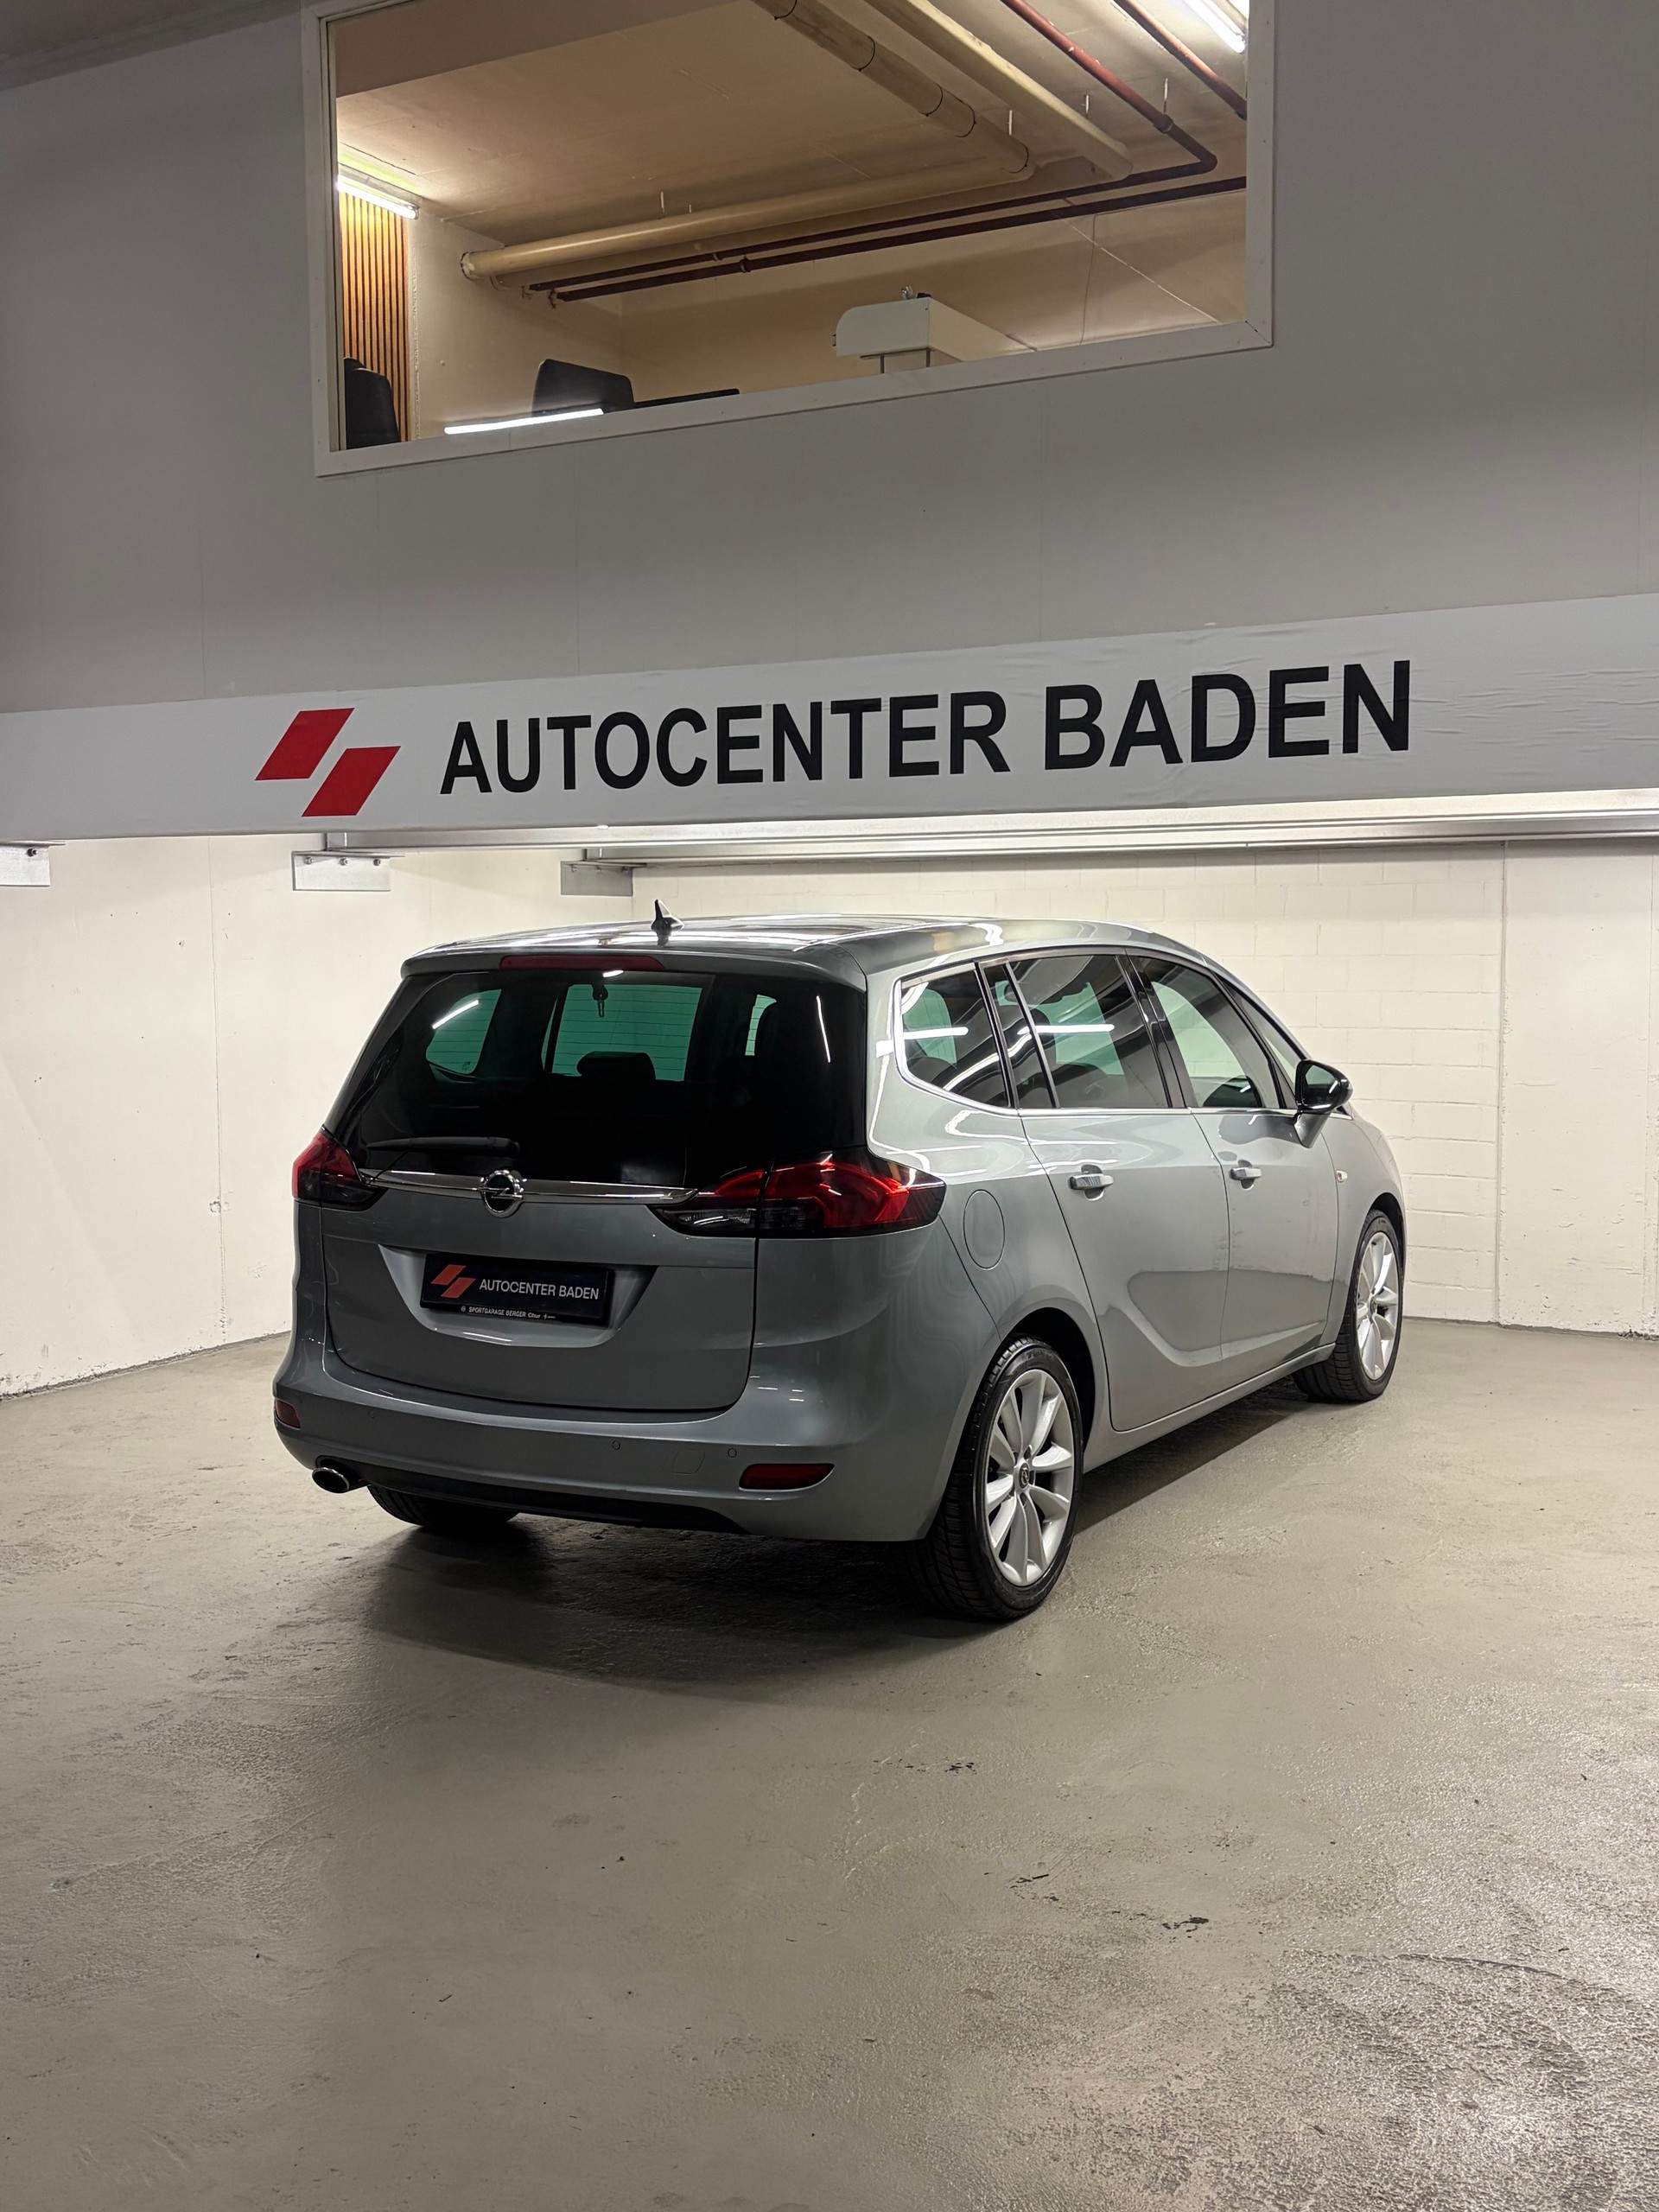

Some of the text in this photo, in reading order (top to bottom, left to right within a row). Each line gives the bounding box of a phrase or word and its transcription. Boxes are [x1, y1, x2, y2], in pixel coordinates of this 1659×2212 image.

[440, 660, 1411, 795] AUTOCENTER BADEN
[479, 1278, 600, 1300] AUTOCENTER BADEN
[468, 1306, 505, 1316] SPORTGARAGE
